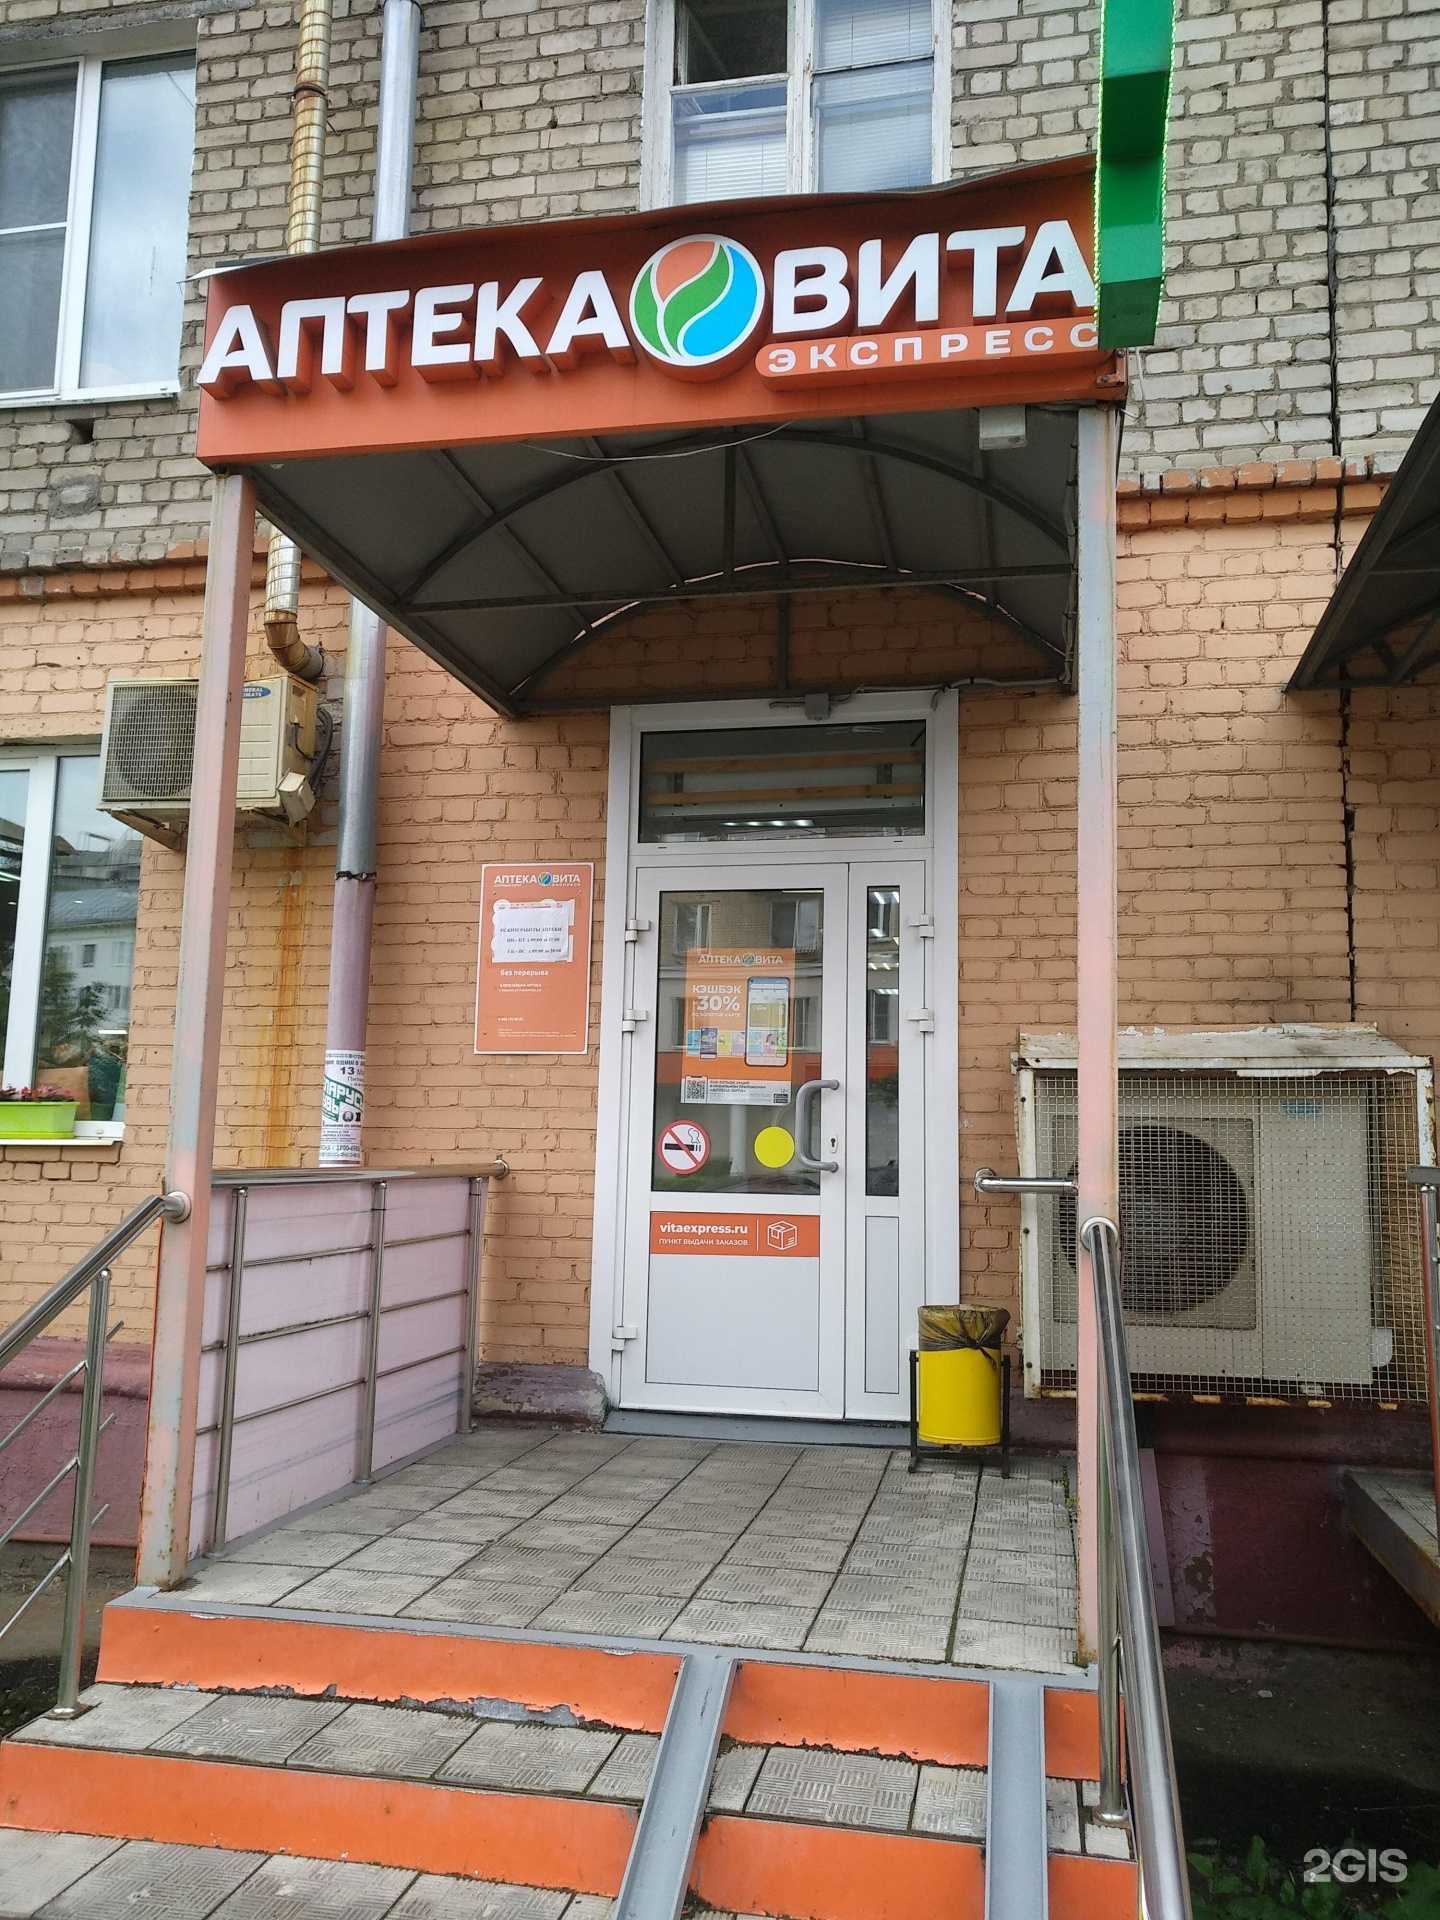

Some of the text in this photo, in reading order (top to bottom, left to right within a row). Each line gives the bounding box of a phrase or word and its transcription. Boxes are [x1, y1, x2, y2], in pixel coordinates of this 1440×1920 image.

[196, 220, 1097, 384] АПТЕКА ВИТА
[768, 323, 1099, 373] ЭКСПРЕСС
[495, 874, 580, 884] АПТЕКА ВИТА
[698, 954, 784, 964] АПТЕКА ВИТА
[692, 984, 741, 994] КЭШБЭК
[696, 995, 740, 1012] 30%
[341, 1066, 355, 1075] 13
[660, 1222, 748, 1235] vitaexpress.ru
